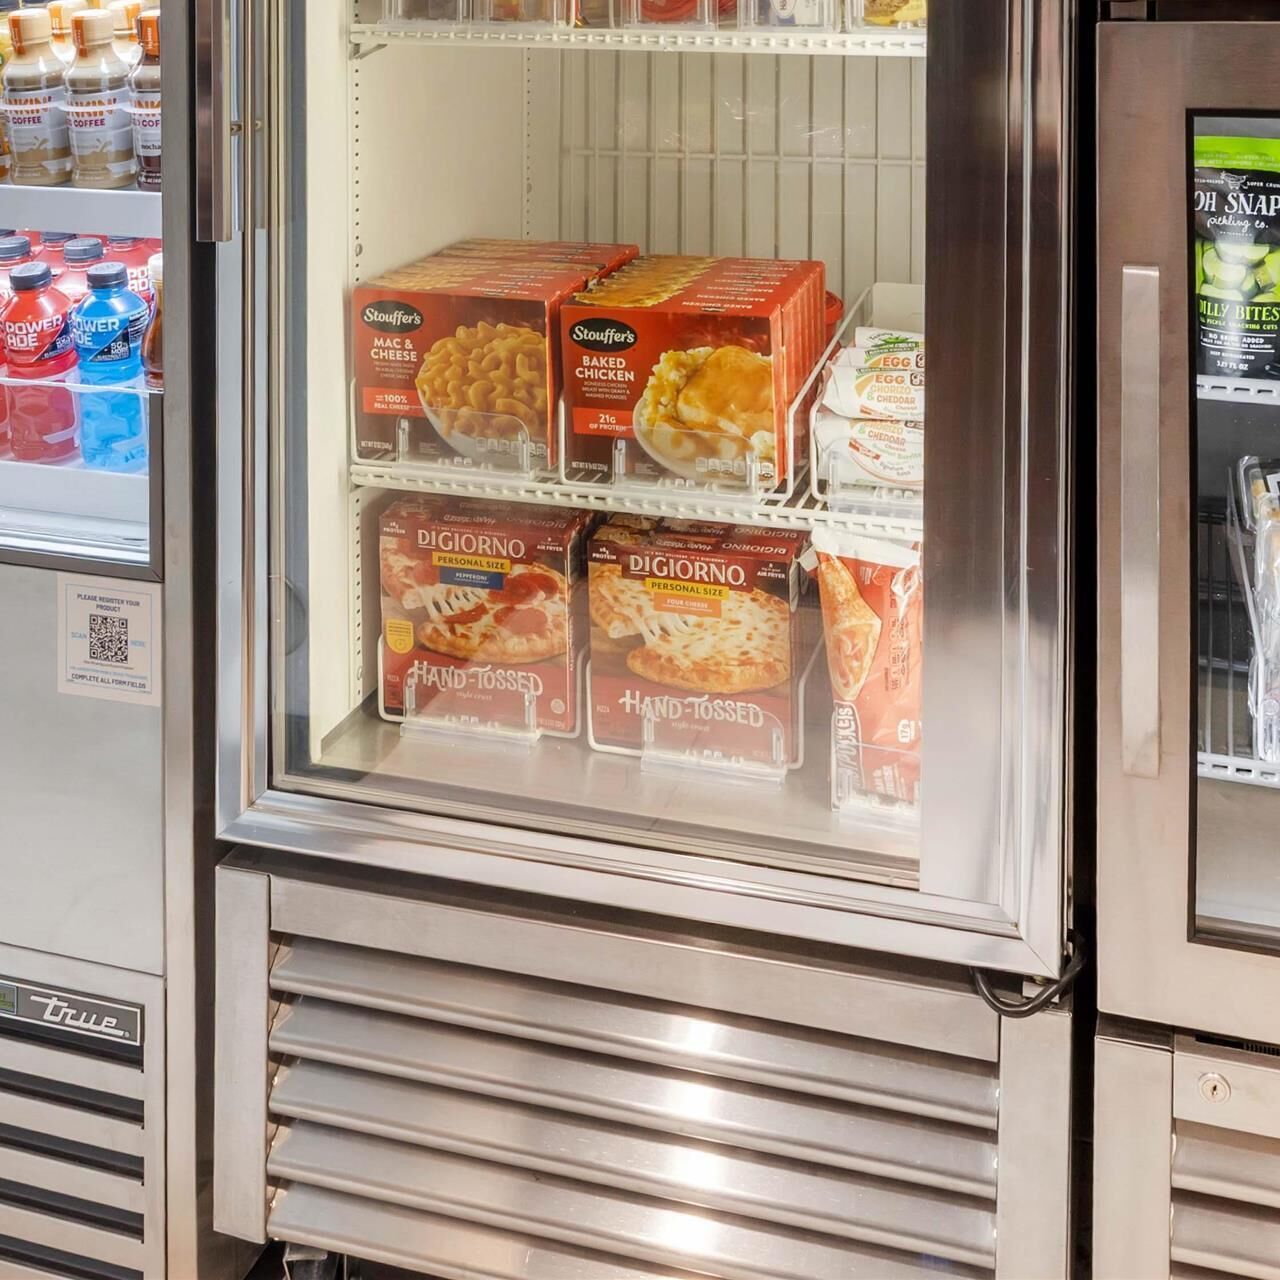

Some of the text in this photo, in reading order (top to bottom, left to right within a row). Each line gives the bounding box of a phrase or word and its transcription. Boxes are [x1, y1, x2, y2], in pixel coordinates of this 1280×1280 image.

[11, 115, 42, 126] COFFEE
[73, 118, 106, 128] COFFEE
[1206, 215, 1269, 233] pickling co.
[363, 307, 421, 325] Stouffer's
[1235, 305, 1280, 322] BITES
[5, 317, 63, 334] POWER
[572, 325, 635, 344] Stouffer's
[1242, 336, 1265, 344] ADDED
[7, 335, 39, 350] ADE
[373, 337, 413, 349] MAC &
[370, 349, 418, 361] CHEESE
[582, 355, 626, 369] BAKED
[882, 356, 911, 368] EGG
[575, 368, 635, 382] CHICKEN
[875, 373, 905, 384] EGG
[384, 394, 408, 403] 100%
[876, 395, 916, 405] CHEDDAR
[867, 430, 907, 446] CHEDDAR
[437, 555, 506, 571] PERSONAL SIZE
[592, 552, 617, 561] PROTEIN
[455, 571, 488, 581] PEPPERONI
[651, 581, 724, 598] PERSONAL SIZE
[77, 593, 141, 607] PLEASE REGISTER YOUR
[666, 598, 681, 606] FOUR
[96, 604, 121, 612] PRODUCT
[71, 672, 99, 683] COMPLETE
[111, 679, 127, 687] FORM
[127, 680, 146, 689] FIELDS
[407, 659, 544, 697] HAND-TOSSED
[618, 689, 764, 728] HAND-TOSSED
[30, 996, 125, 1036] true
